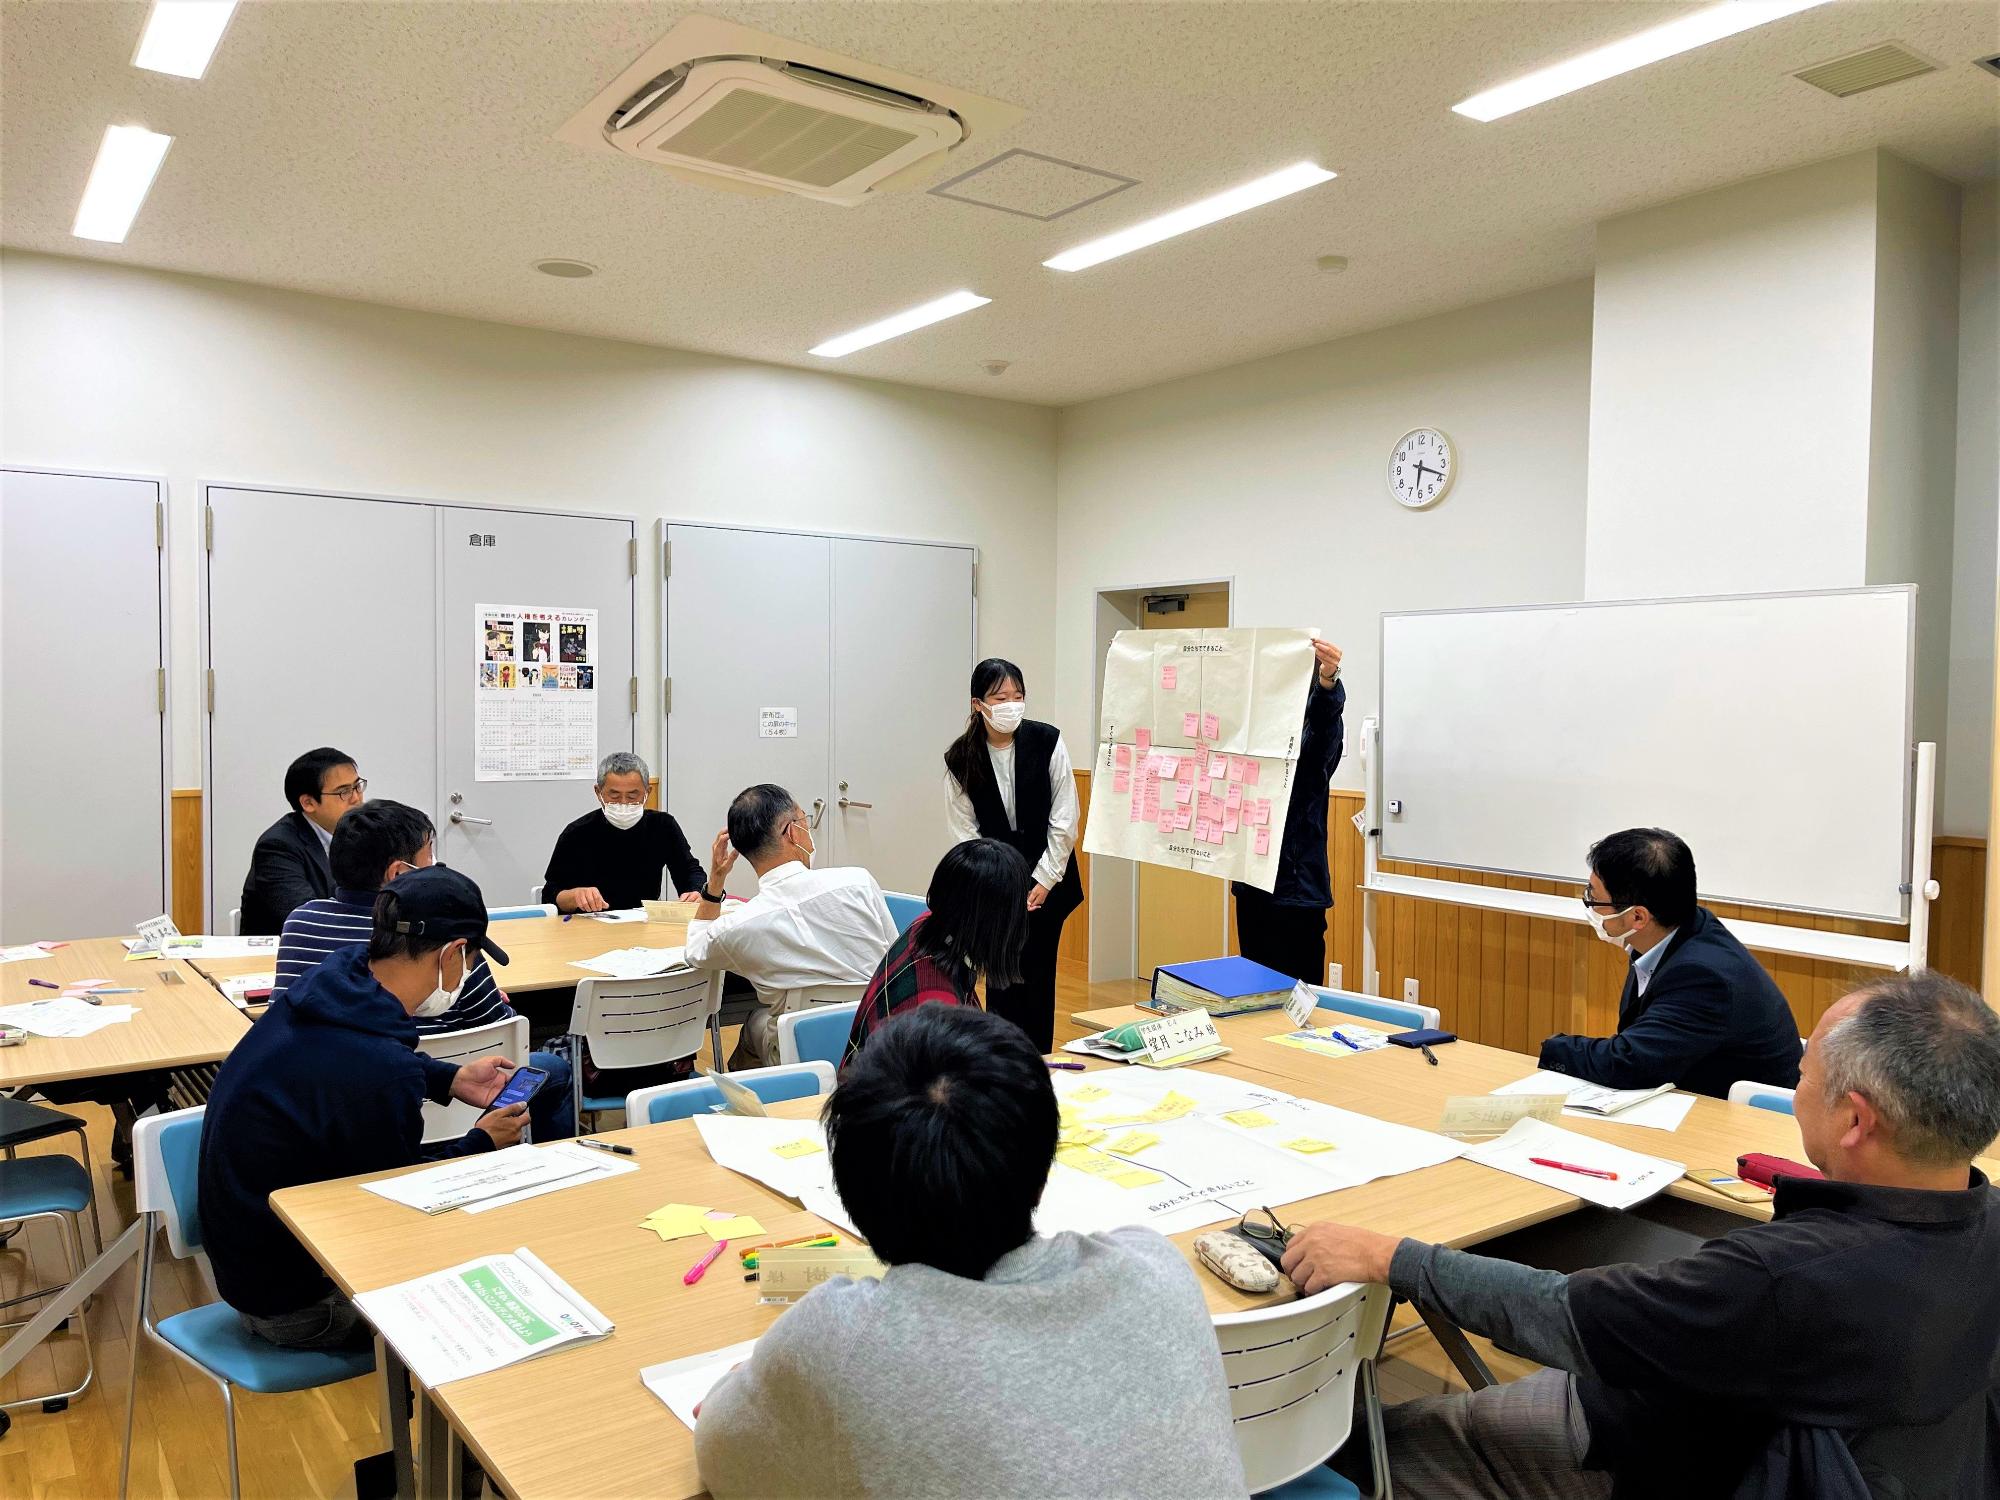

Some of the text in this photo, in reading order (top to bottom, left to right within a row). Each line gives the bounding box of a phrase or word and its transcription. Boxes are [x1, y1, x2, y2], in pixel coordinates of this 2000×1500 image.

[1418, 434, 1425, 444] 12
[1408, 441, 1413, 450] 11
[1438, 445, 1442, 455] 2
[1399, 452, 1406, 461] 10
[1441, 459, 1446, 468] 3
[1397, 466, 1401, 475] 9
[1399, 479, 1404, 488] 8
[1408, 487, 1413, 497] 7
[1418, 490, 1423, 498] 6
[1428, 484, 1433, 494] 5
[469, 533, 496, 547] 倉庫
[1148, 1023, 1217, 1053] 望月 こなみ 様
[1148, 1180, 1254, 1212] 自分たちでできないこと
